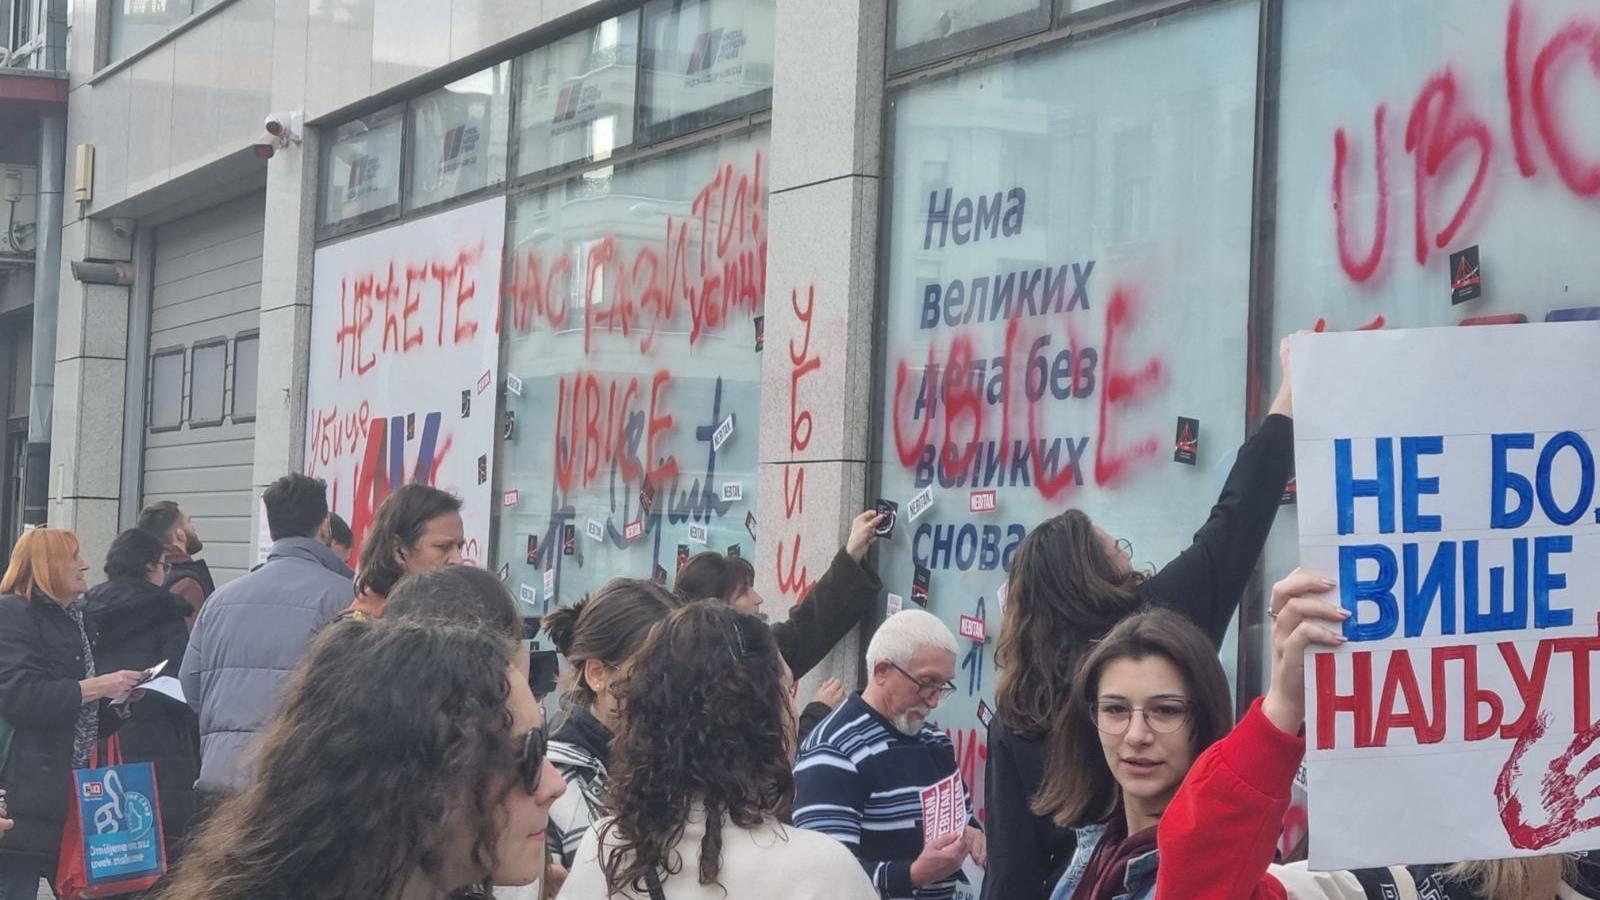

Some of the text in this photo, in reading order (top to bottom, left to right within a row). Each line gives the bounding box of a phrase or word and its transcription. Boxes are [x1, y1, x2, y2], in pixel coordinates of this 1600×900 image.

[923, 186, 1027, 250] Нема
[919, 260, 1097, 330] великих
[890, 285, 1163, 500] UBICE
[1025, 335, 1099, 401] без
[554, 366, 682, 492] UBICE
[1334, 430, 1600, 535] НЕ БО
[1338, 535, 1574, 642] ВИШЕ
[1315, 637, 1600, 750] НАЉУТ
